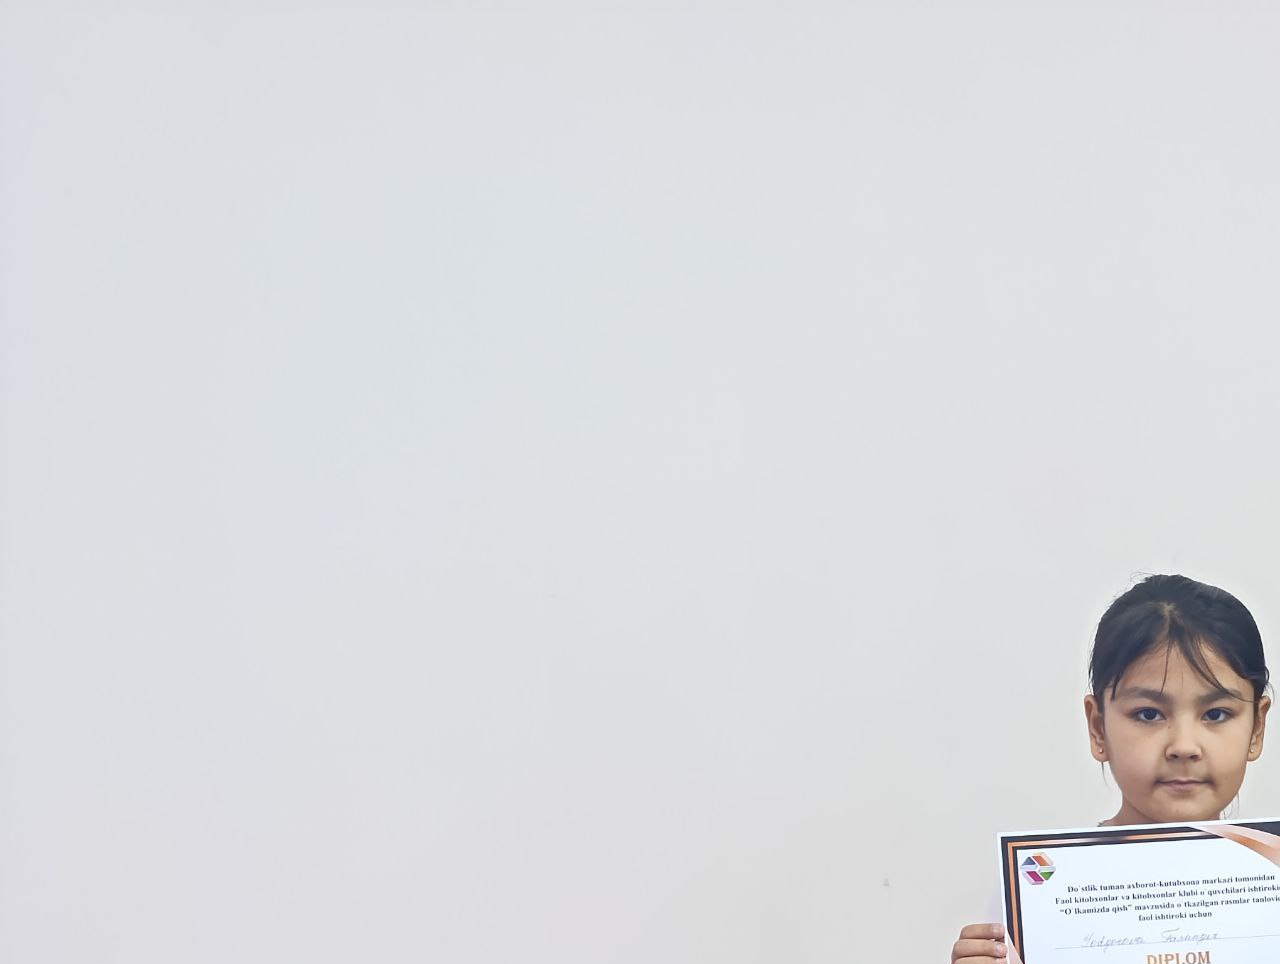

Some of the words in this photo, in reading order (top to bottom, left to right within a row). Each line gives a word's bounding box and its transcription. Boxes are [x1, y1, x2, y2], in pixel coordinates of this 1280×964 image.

[1202, 877, 1233, 885] markazi
[1235, 874, 1275, 883] tomonidan
[1055, 897, 1072, 905] Faol
[1074, 894, 1119, 904] kitobxonlar
[1132, 891, 1177, 900] kitobxonlar
[1178, 889, 1198, 897] klubi
[1134, 902, 1175, 911] mavzusida
[1221, 897, 1251, 906] rasmlar
[1155, 911, 1187, 920] ishtiroki
[1189, 911, 1212, 919] uchun
